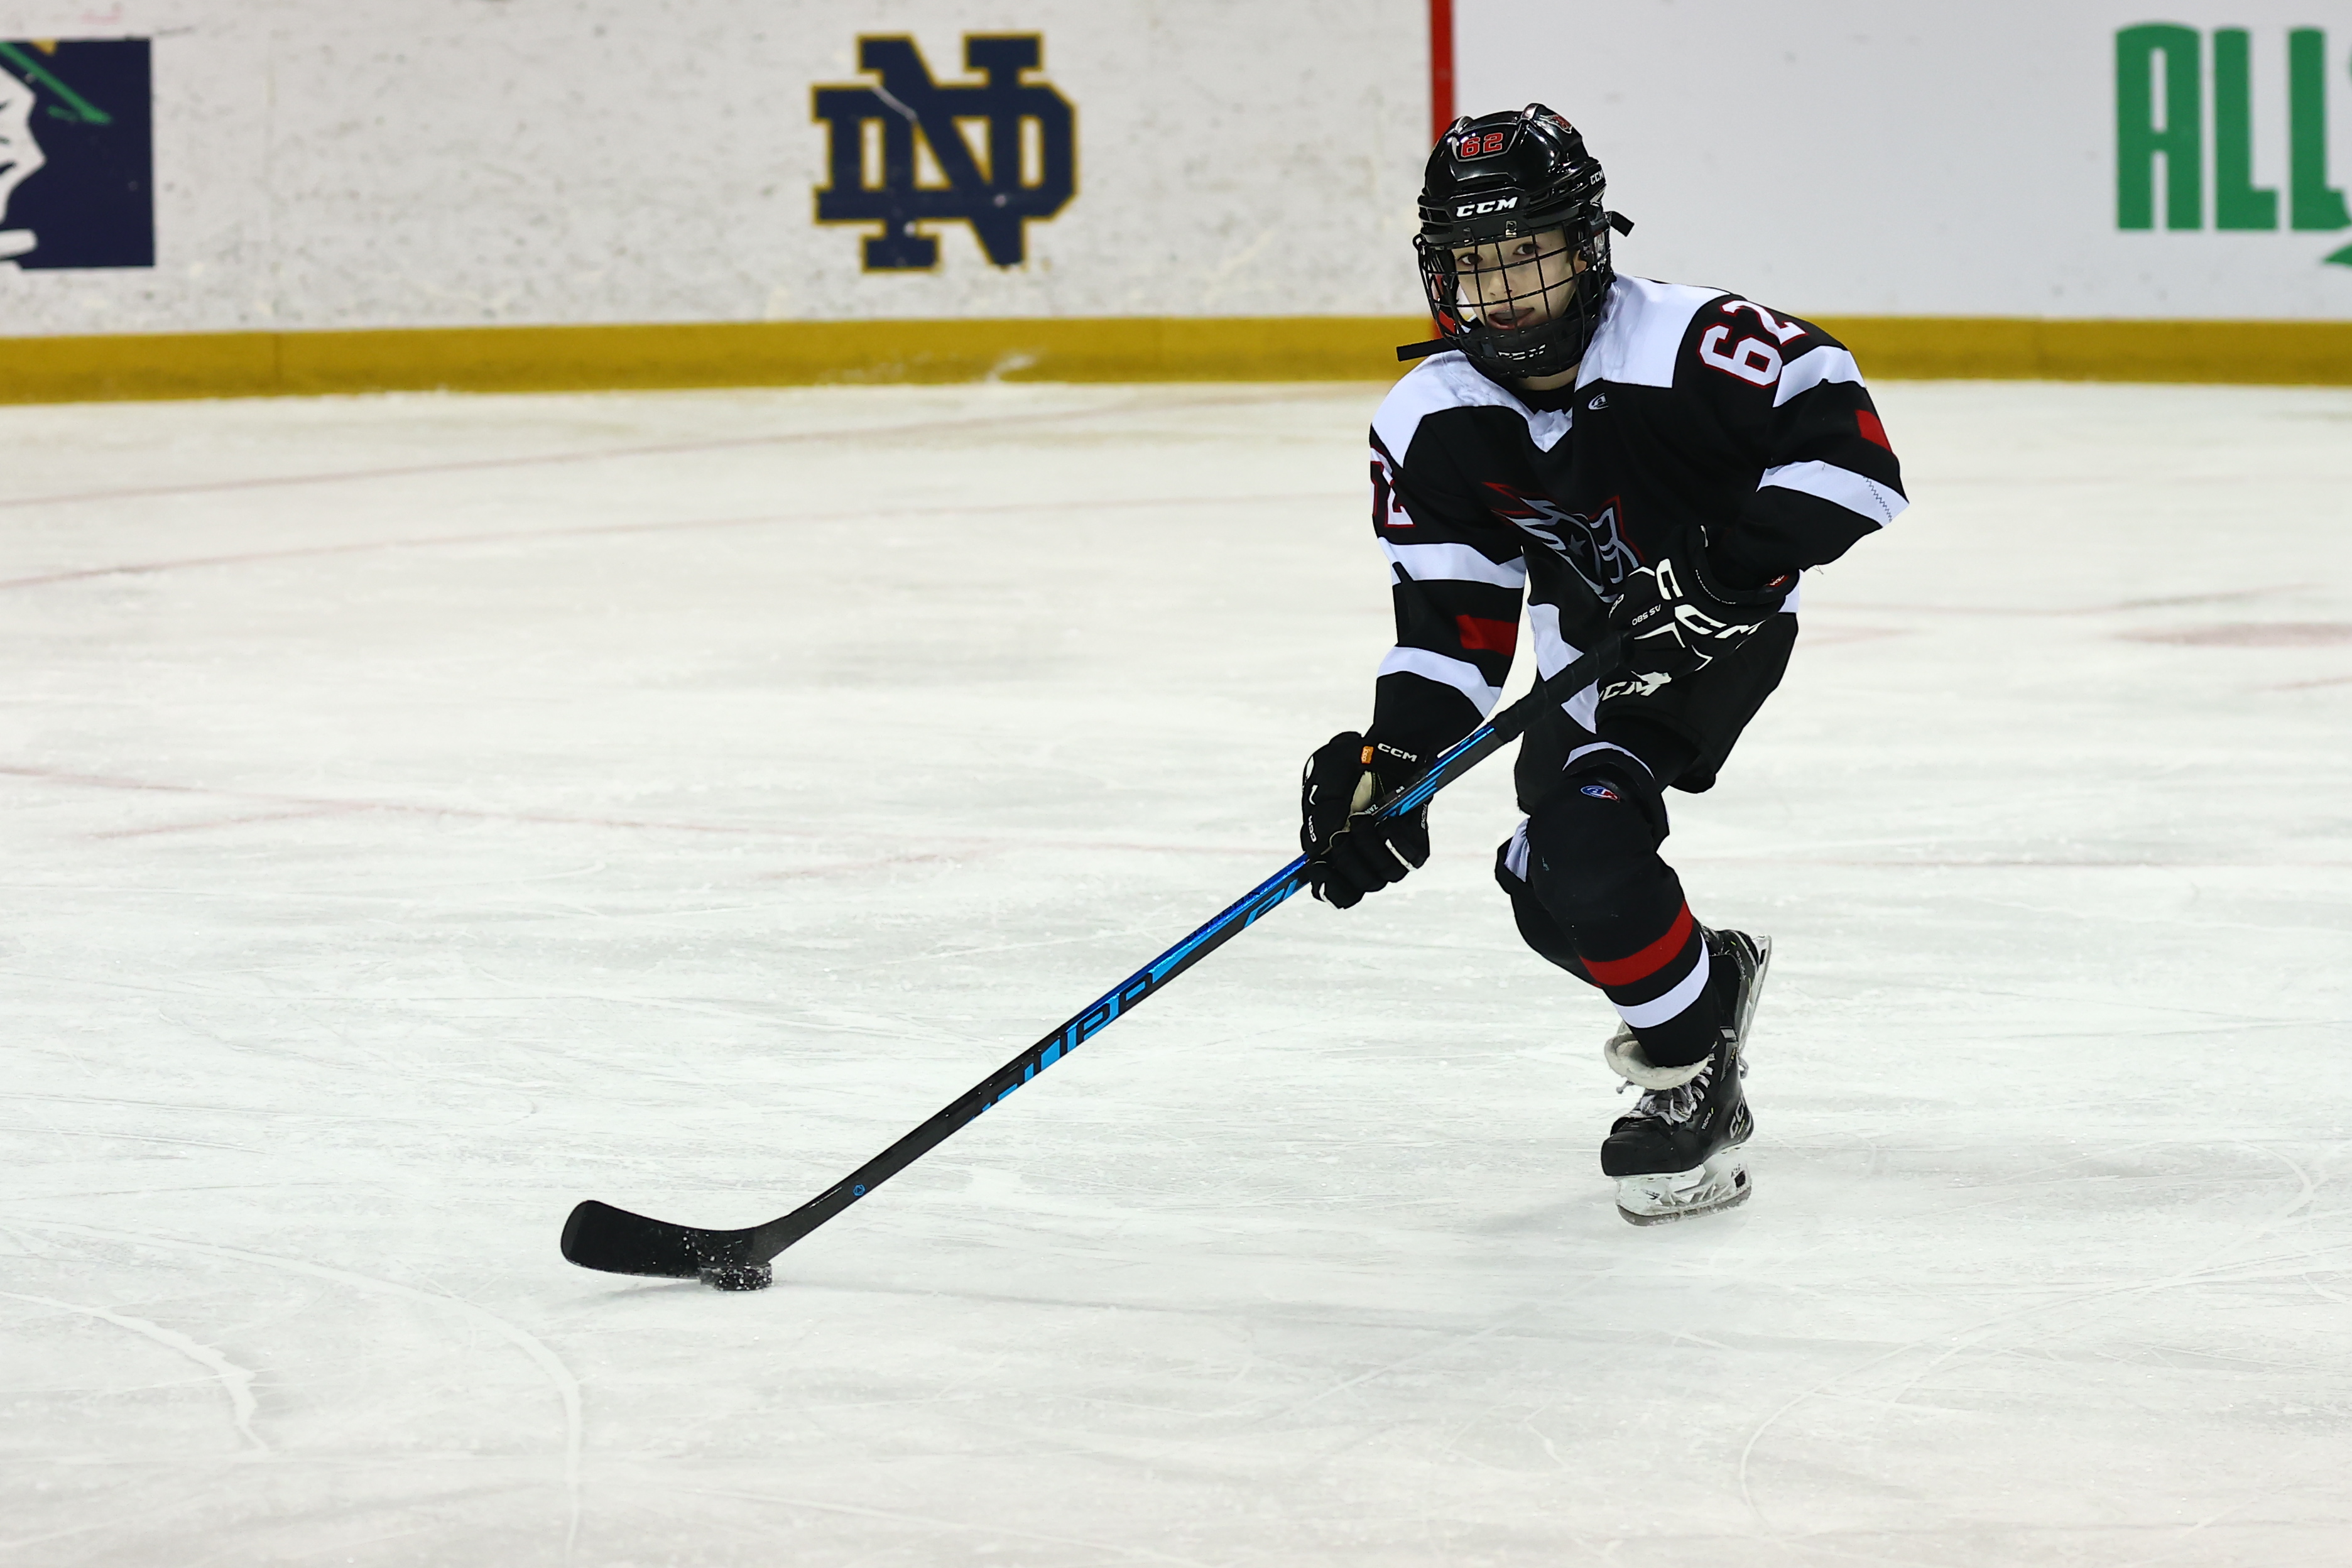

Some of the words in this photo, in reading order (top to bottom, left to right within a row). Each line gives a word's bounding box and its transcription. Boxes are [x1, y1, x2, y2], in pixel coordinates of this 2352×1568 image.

[2115, 22, 2352, 231] ALL
[1461, 133, 1503, 157] 62
[1590, 169, 1604, 185] CCM
[1456, 197, 1518, 218] CCM
[1698, 300, 1809, 389] 62
[1370, 444, 1417, 528] 2
[1599, 681, 1661, 701] CM
[1378, 743, 1418, 763] CCM
[1308, 814, 1317, 842] CCM
